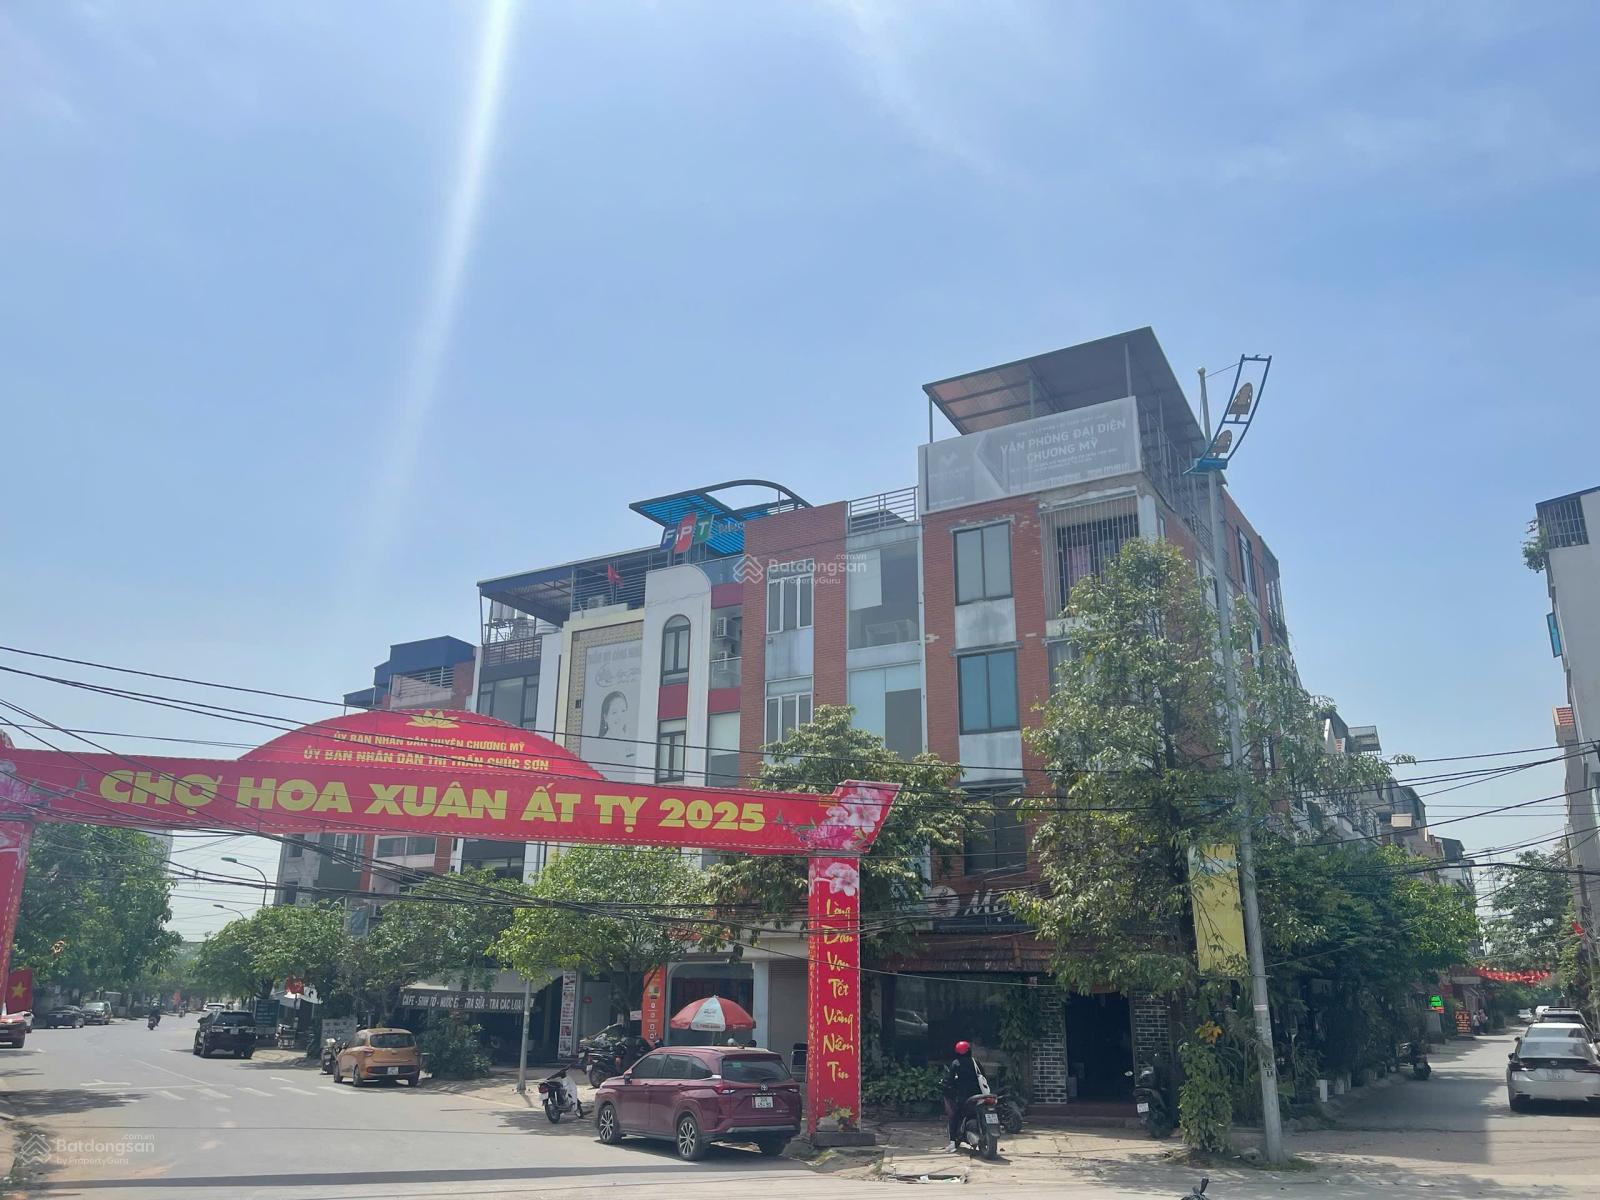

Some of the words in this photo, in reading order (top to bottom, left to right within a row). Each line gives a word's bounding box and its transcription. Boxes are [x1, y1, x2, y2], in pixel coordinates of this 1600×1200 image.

[663, 521, 710, 545] FPT
[349, 734, 372, 746] BAN
[466, 739, 508, 752] CHƯƠNG
[509, 741, 526, 752] MỸ
[325, 750, 353, 762] BAN
[356, 750, 393, 764] NHÂN
[396, 752, 424, 765] DÂN
[523, 759, 550, 771] SƠN
[100, 769, 223, 815] CHỢ
[236, 777, 353, 813] HOA
[364, 781, 508, 820] XUÂN
[520, 783, 581, 823] ẤT
[594, 794, 648, 833] TỴ
[658, 798, 766, 832] 2025
[828, 978, 849, 999] Tết
[823, 1005, 854, 1041] Vững
[822, 1033, 854, 1055] Niềm
[827, 1061, 849, 1083] Tin
